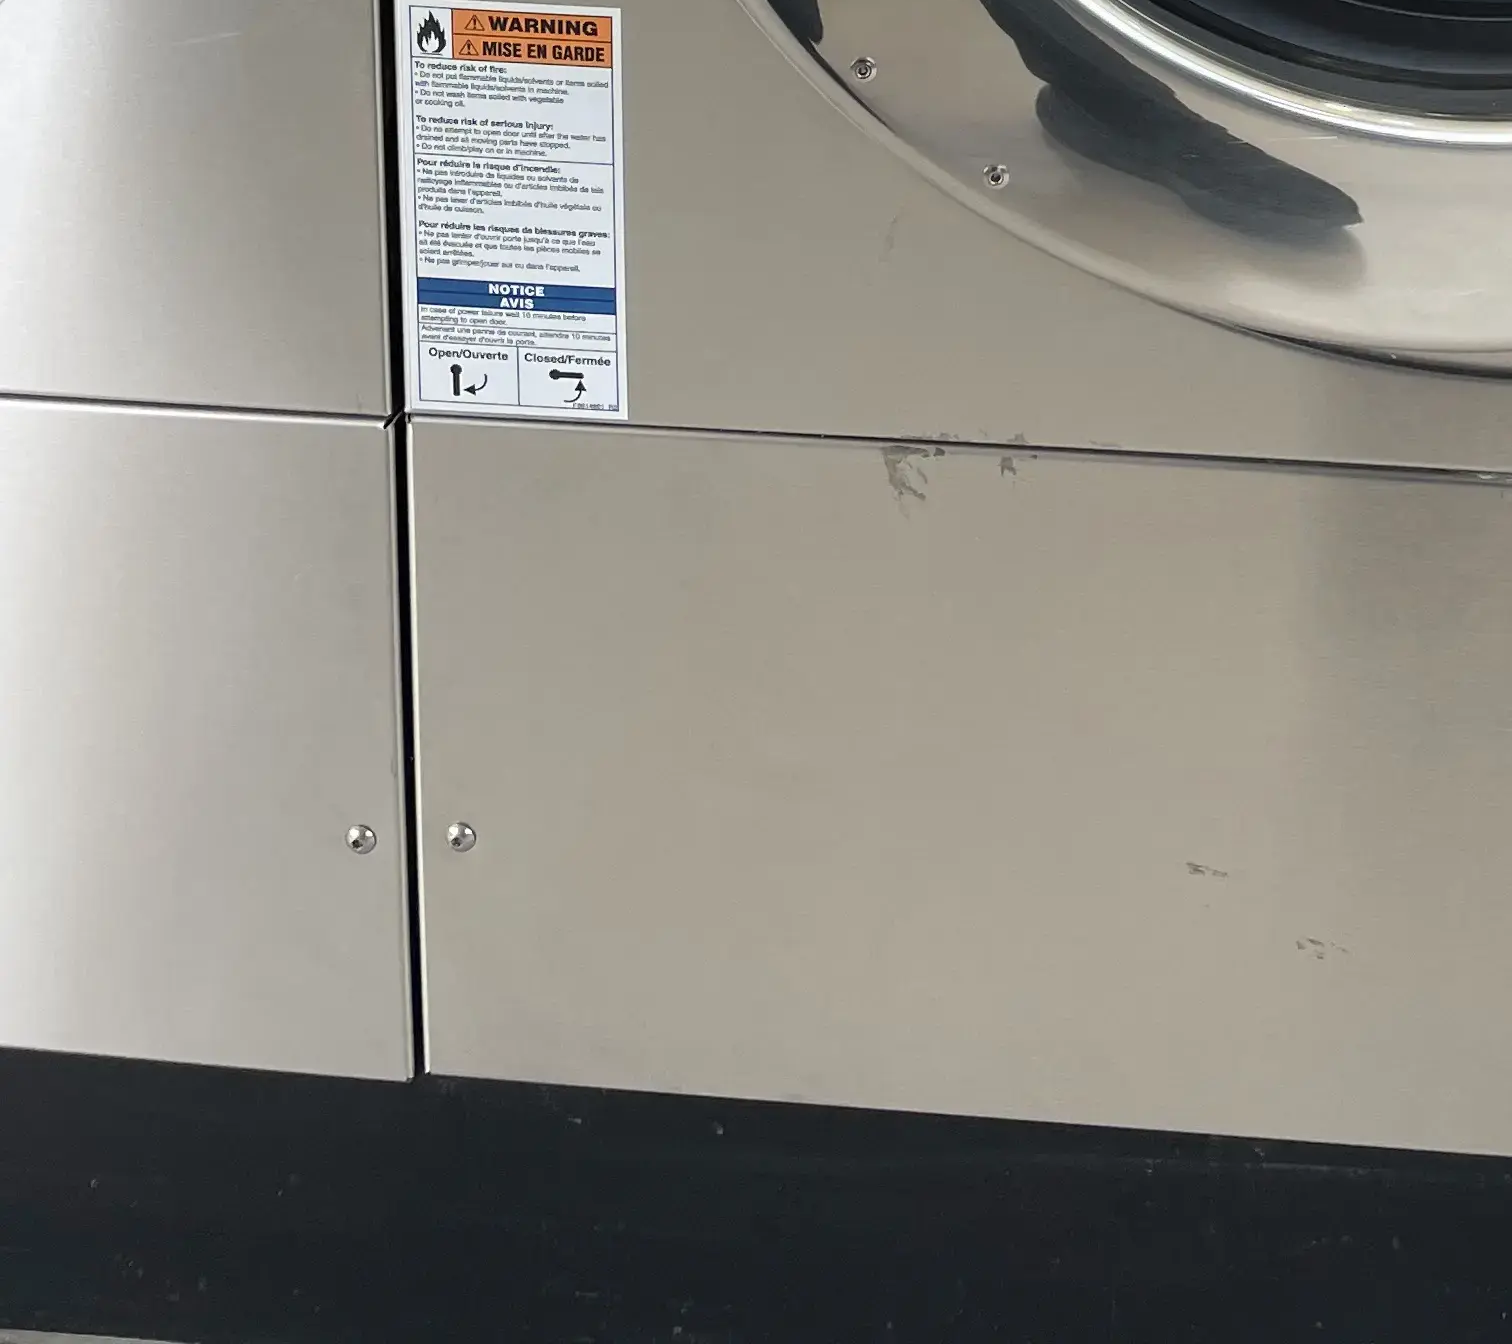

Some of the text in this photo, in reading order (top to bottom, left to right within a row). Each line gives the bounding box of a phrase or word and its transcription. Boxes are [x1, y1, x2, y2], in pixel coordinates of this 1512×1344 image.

[488, 15, 598, 36] WARNING
[482, 42, 605, 62] MISE EN GARDE
[415, 61, 425, 69] To
[428, 62, 457, 71] reduce
[460, 64, 476, 72] risk
[478, 65, 488, 73] of
[416, 115, 426, 123] To
[429, 116, 459, 125] reduce
[461, 117, 477, 126] risk
[490, 120, 523, 128] serious
[417, 158, 438, 167] Pour
[440, 160, 470, 169] réduire
[472, 162, 480, 170] le
[483, 162, 510, 173] risque
[419, 220, 438, 228] Pour
[441, 221, 471, 230] réduire
[488, 224, 519, 234] risques
[522, 226, 532, 234] de
[488, 283, 544, 297] NOTICE
[500, 298, 534, 309] AVIS
[428, 347, 508, 360] Open/Ouverte
[524, 352, 611, 366] Closed/Fermée
